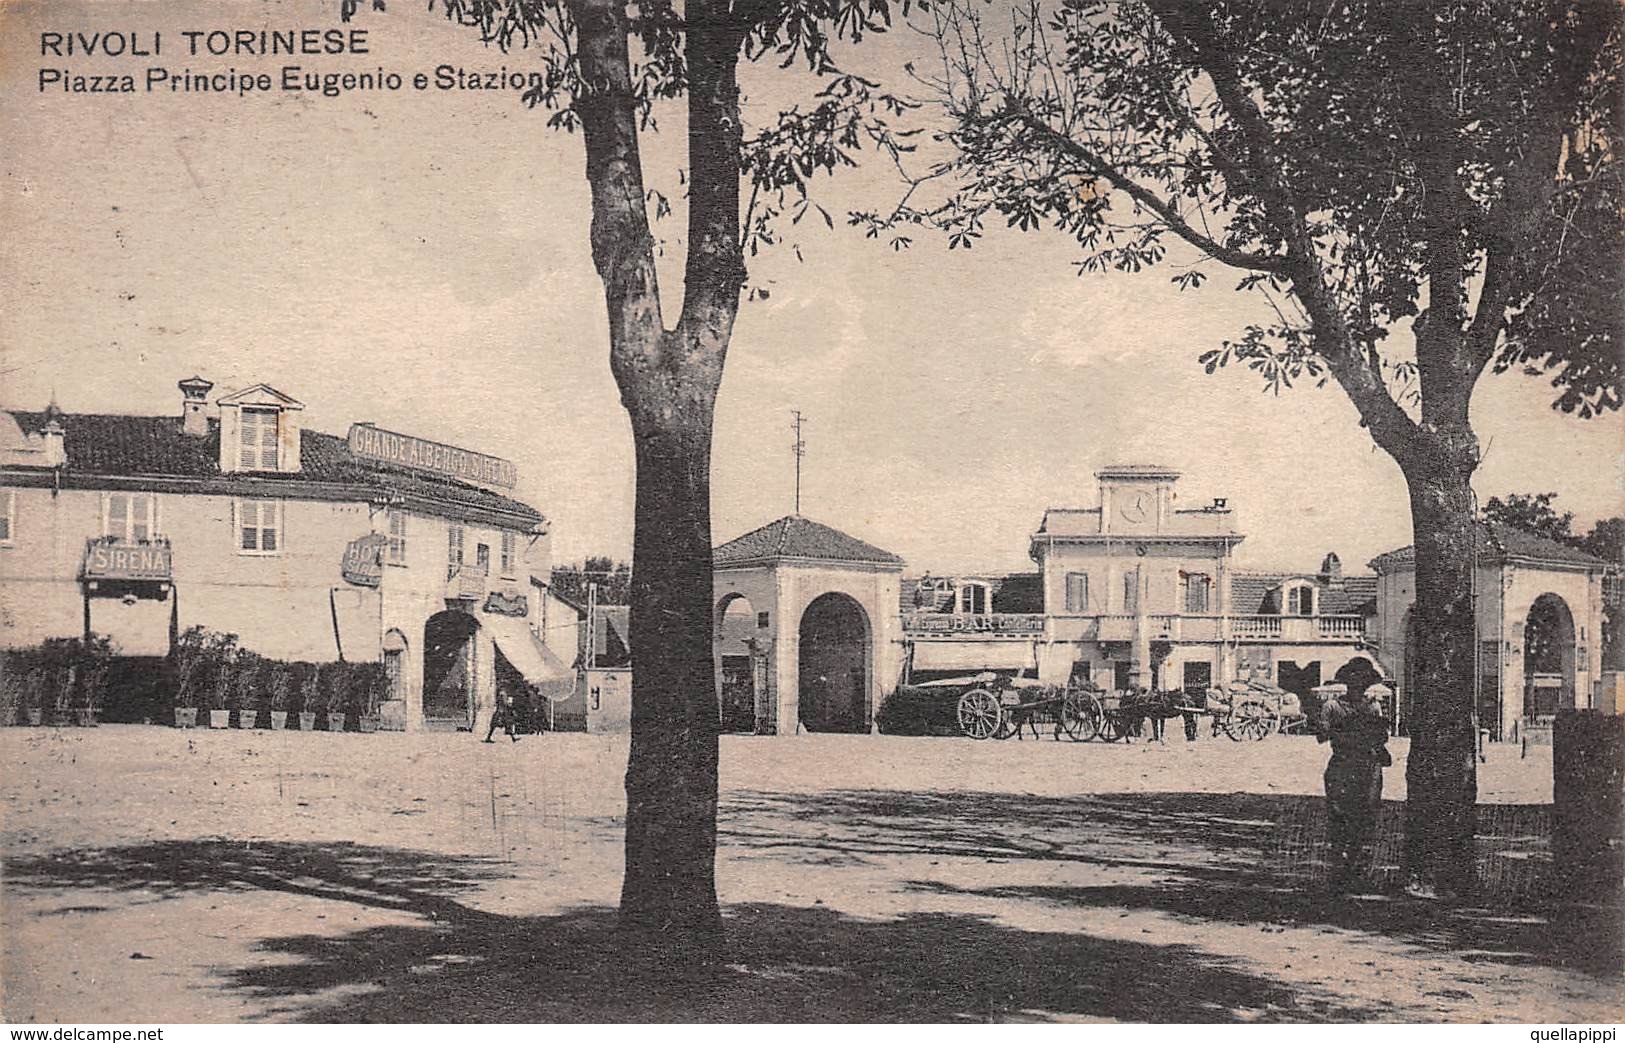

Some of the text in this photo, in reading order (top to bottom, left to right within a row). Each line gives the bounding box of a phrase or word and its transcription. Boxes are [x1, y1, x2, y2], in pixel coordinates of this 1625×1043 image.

[354, 426, 406, 461] GRANDE
[409, 438, 467, 474] ALBERGO
[95, 548, 165, 571] SIRENA
[953, 615, 995, 630] BAR
